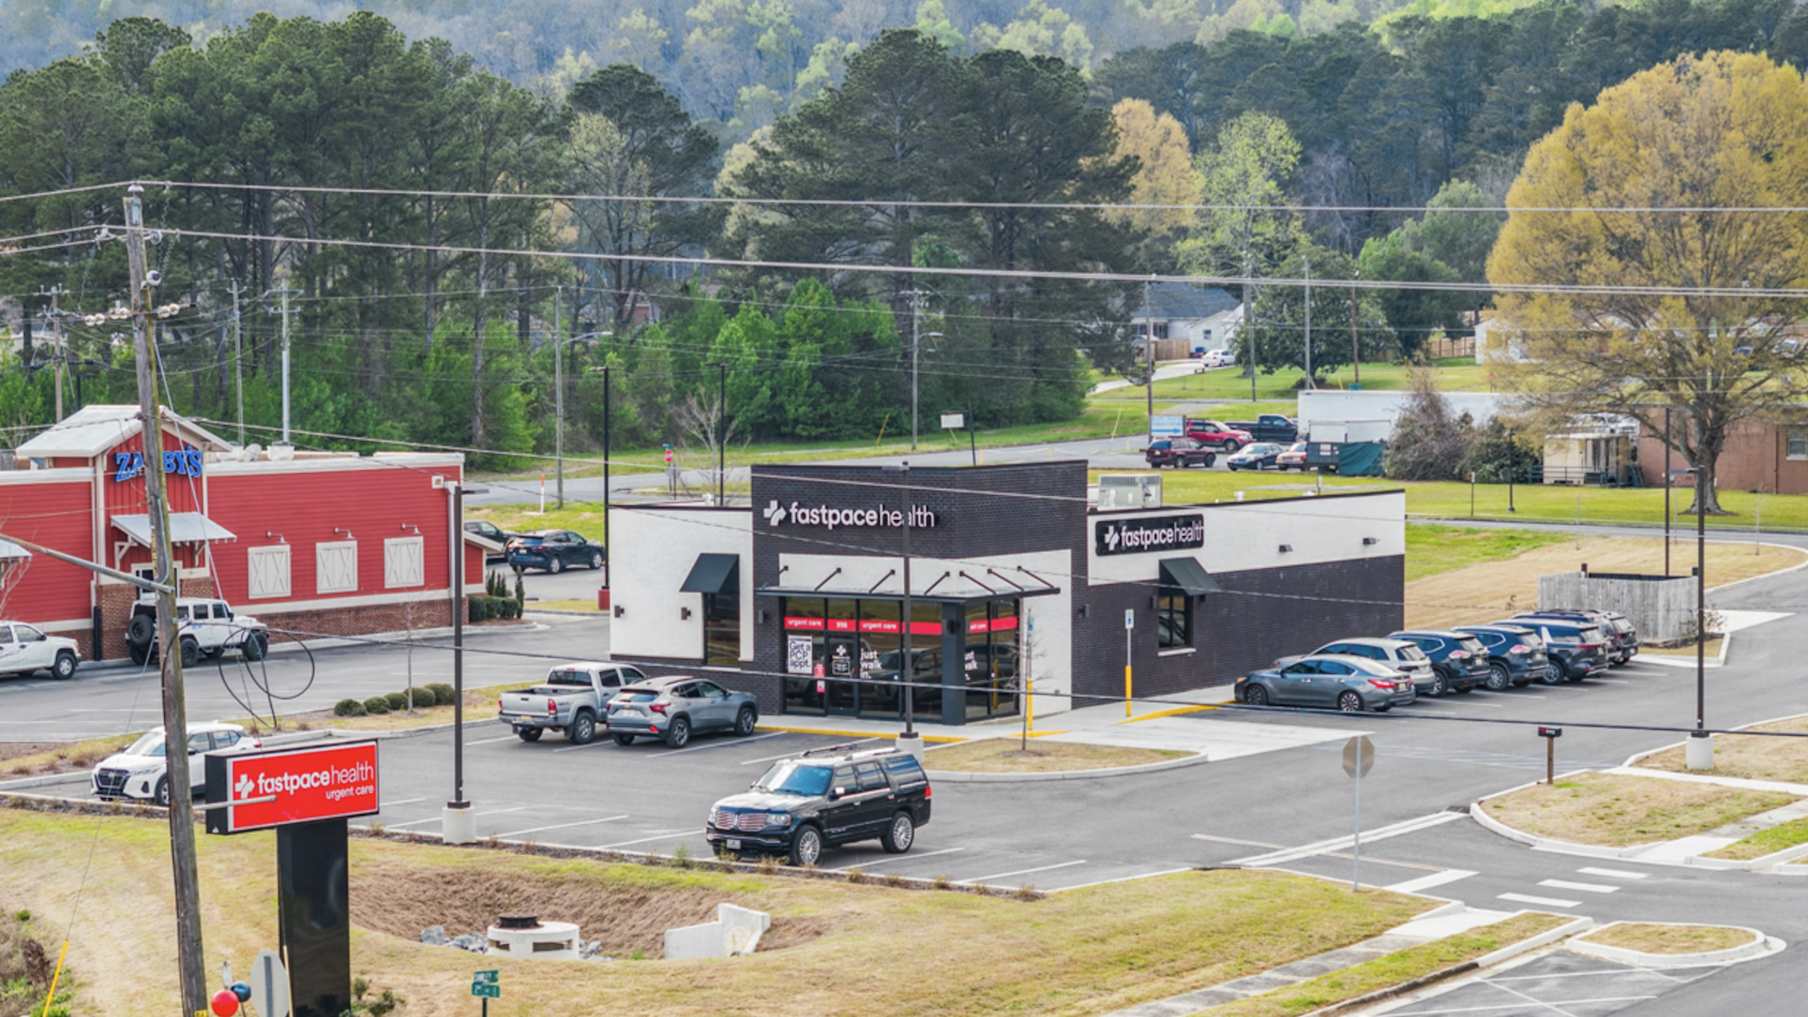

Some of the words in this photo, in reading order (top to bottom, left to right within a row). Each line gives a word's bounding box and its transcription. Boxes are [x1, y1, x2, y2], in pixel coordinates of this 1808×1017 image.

[115, 444, 203, 482] ZABY'S
[258, 761, 374, 795] fastpacehealth
[325, 787, 353, 801] urgent
[355, 785, 374, 796] care
